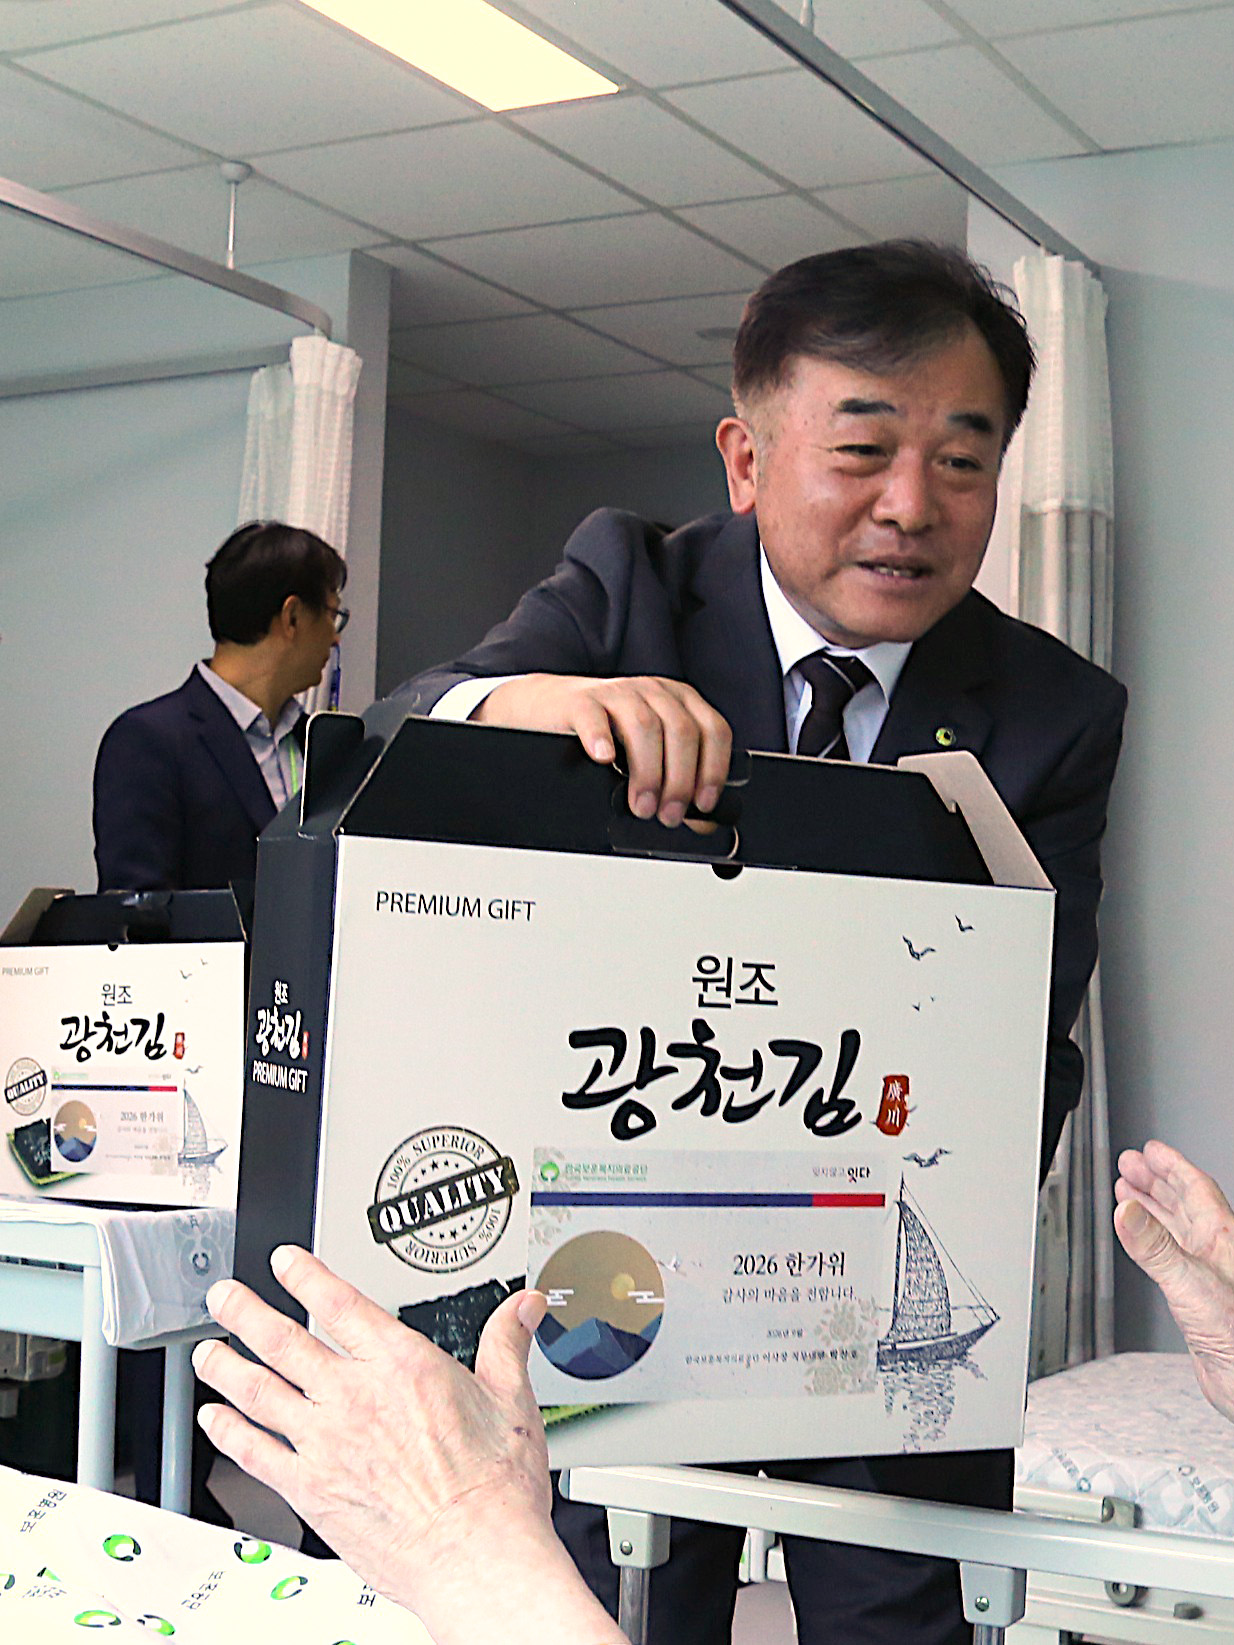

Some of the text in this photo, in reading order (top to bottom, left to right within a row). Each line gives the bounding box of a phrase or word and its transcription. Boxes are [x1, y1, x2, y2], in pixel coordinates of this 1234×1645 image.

[375, 890, 536, 922] PREMIUM GIFT
[101, 984, 133, 1006] 원조
[274, 980, 289, 1005] 원조
[692, 955, 779, 1009] 원조
[60, 1011, 167, 1063] 광천김
[256, 1005, 301, 1059] 광천김
[6, 1072, 45, 1101] QUALITY
[253, 1060, 308, 1093] PREMIUM GIFT
[562, 1018, 862, 1140] 광천김
[387, 1133, 485, 1189] 100% SUPERIOR
[378, 1166, 505, 1233] QUALITY
[405, 1209, 501, 1264] 100% SUPERIOR
[733, 1252, 846, 1277] 2026 한가위
[764, 1287, 800, 1303] 마음을
